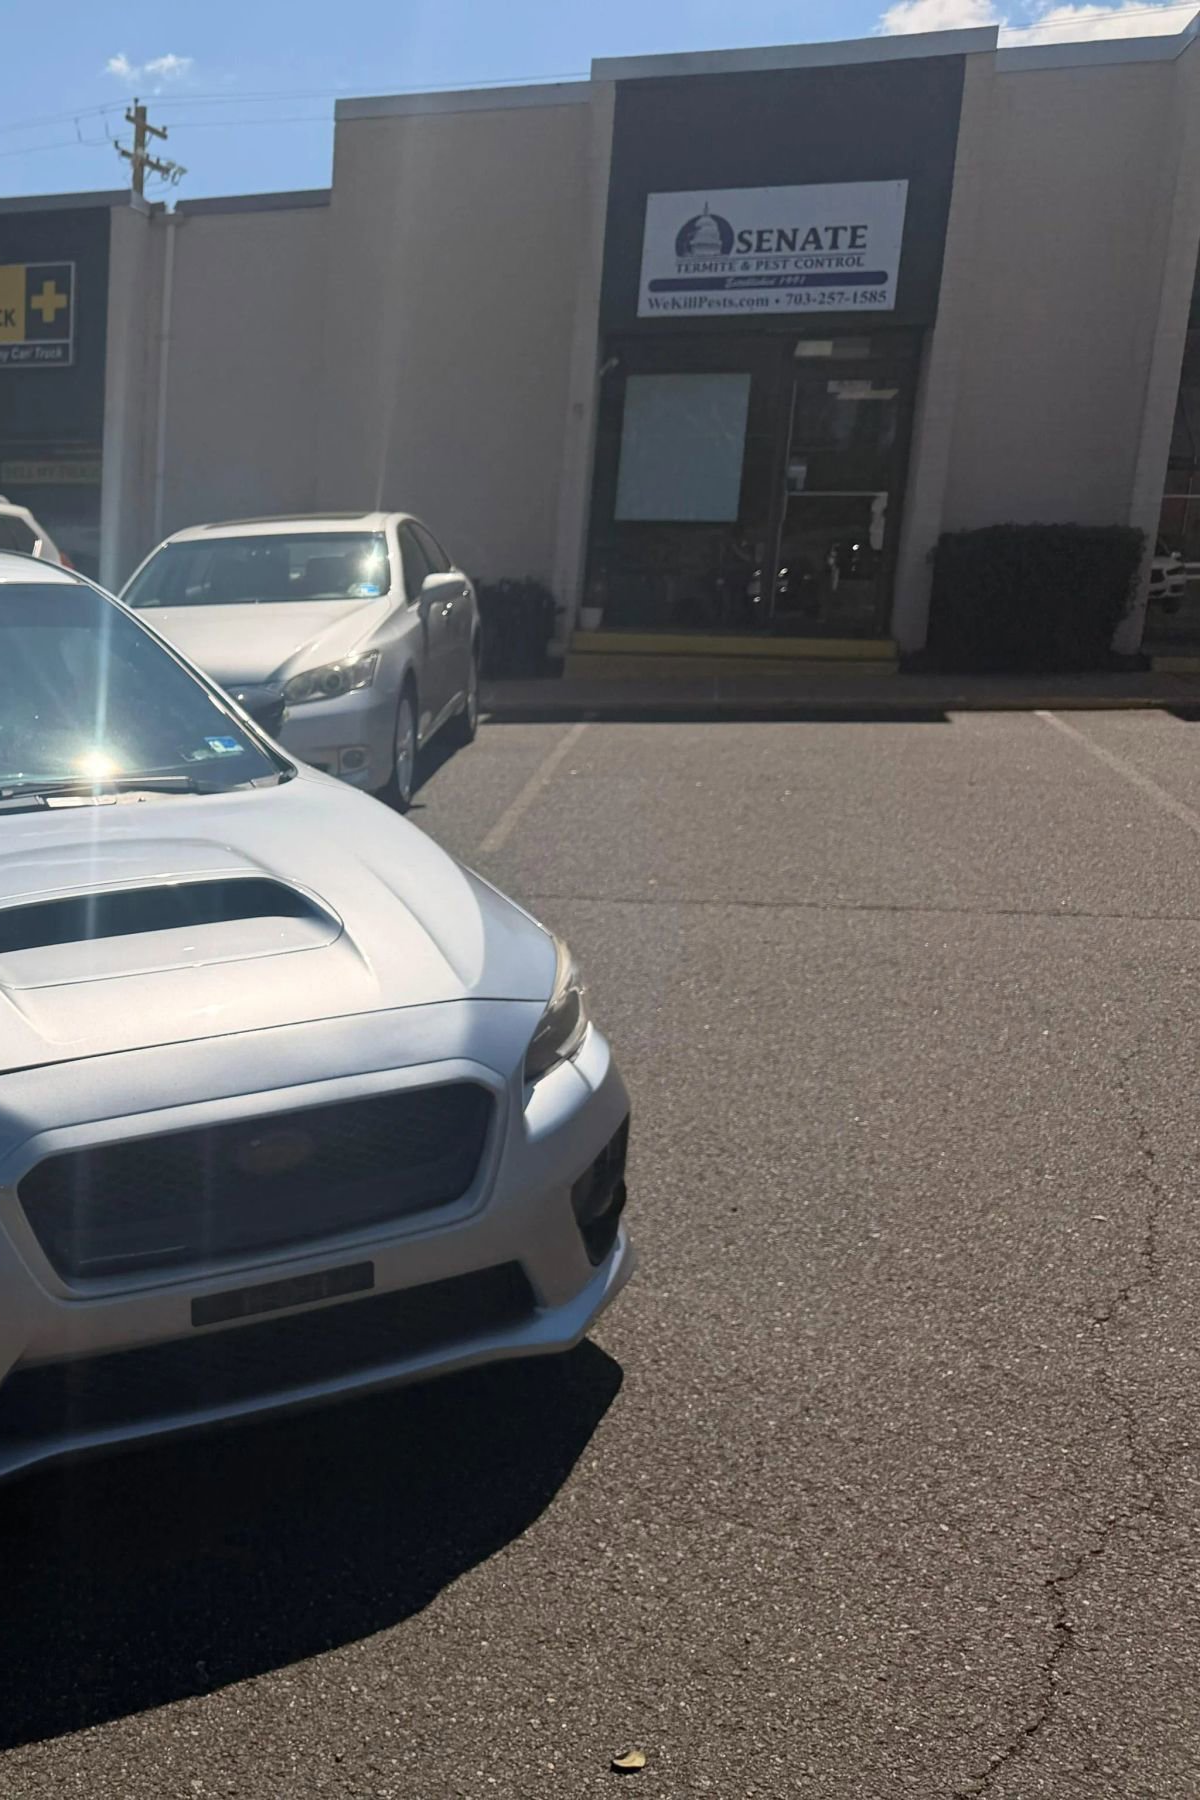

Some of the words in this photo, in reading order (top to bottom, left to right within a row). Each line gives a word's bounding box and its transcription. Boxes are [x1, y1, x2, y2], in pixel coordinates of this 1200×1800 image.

[735, 225, 869, 255] SENATE
[677, 259, 736, 274] TERMITE
[740, 260, 751, 271] &
[755, 258, 790, 272] PEST
[794, 256, 865, 270] CONTROL
[648, 295, 769, 311] WeKillPests.com
[785, 289, 888, 306] 703-257-1585
